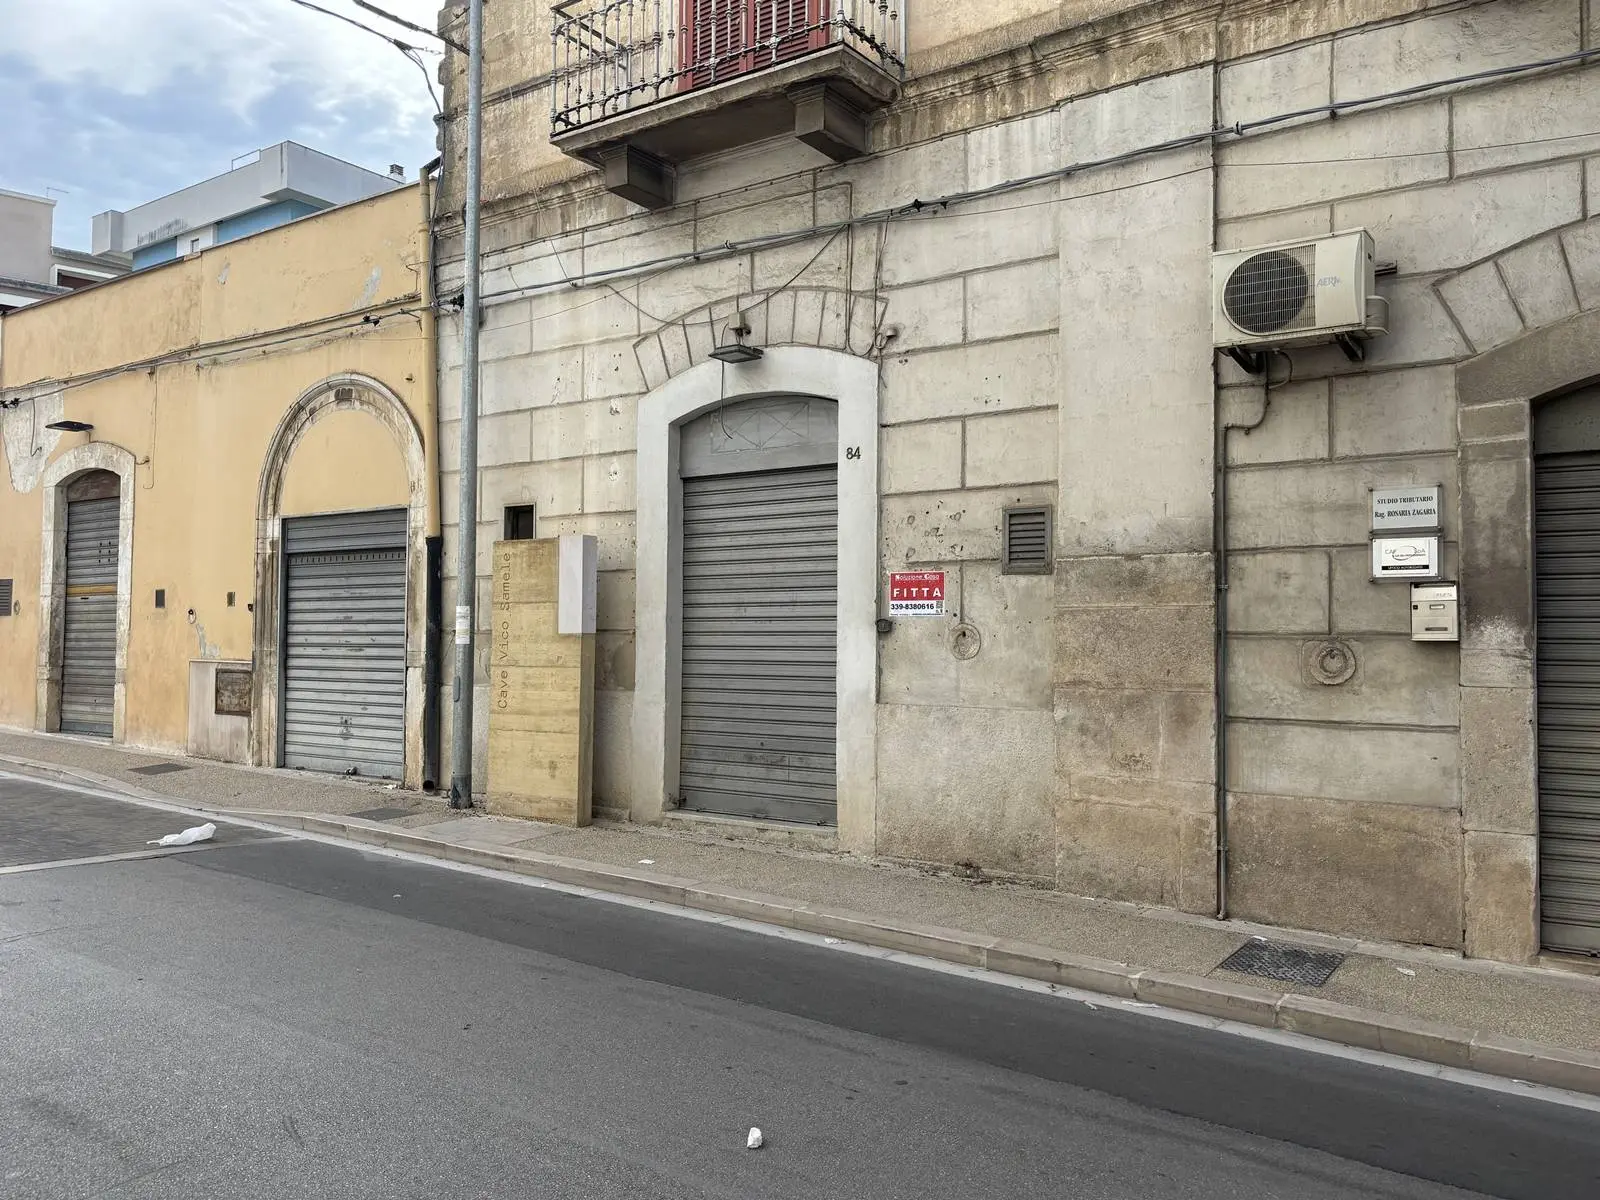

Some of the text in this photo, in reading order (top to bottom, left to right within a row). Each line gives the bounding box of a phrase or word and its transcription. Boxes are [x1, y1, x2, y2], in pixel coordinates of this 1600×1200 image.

[846, 446, 862, 460] 84
[1375, 508, 1436, 519] Rag. ROSARIA ZAGARIA
[893, 587, 942, 598] FITTA
[497, 552, 512, 709] Cave Vico Samele
